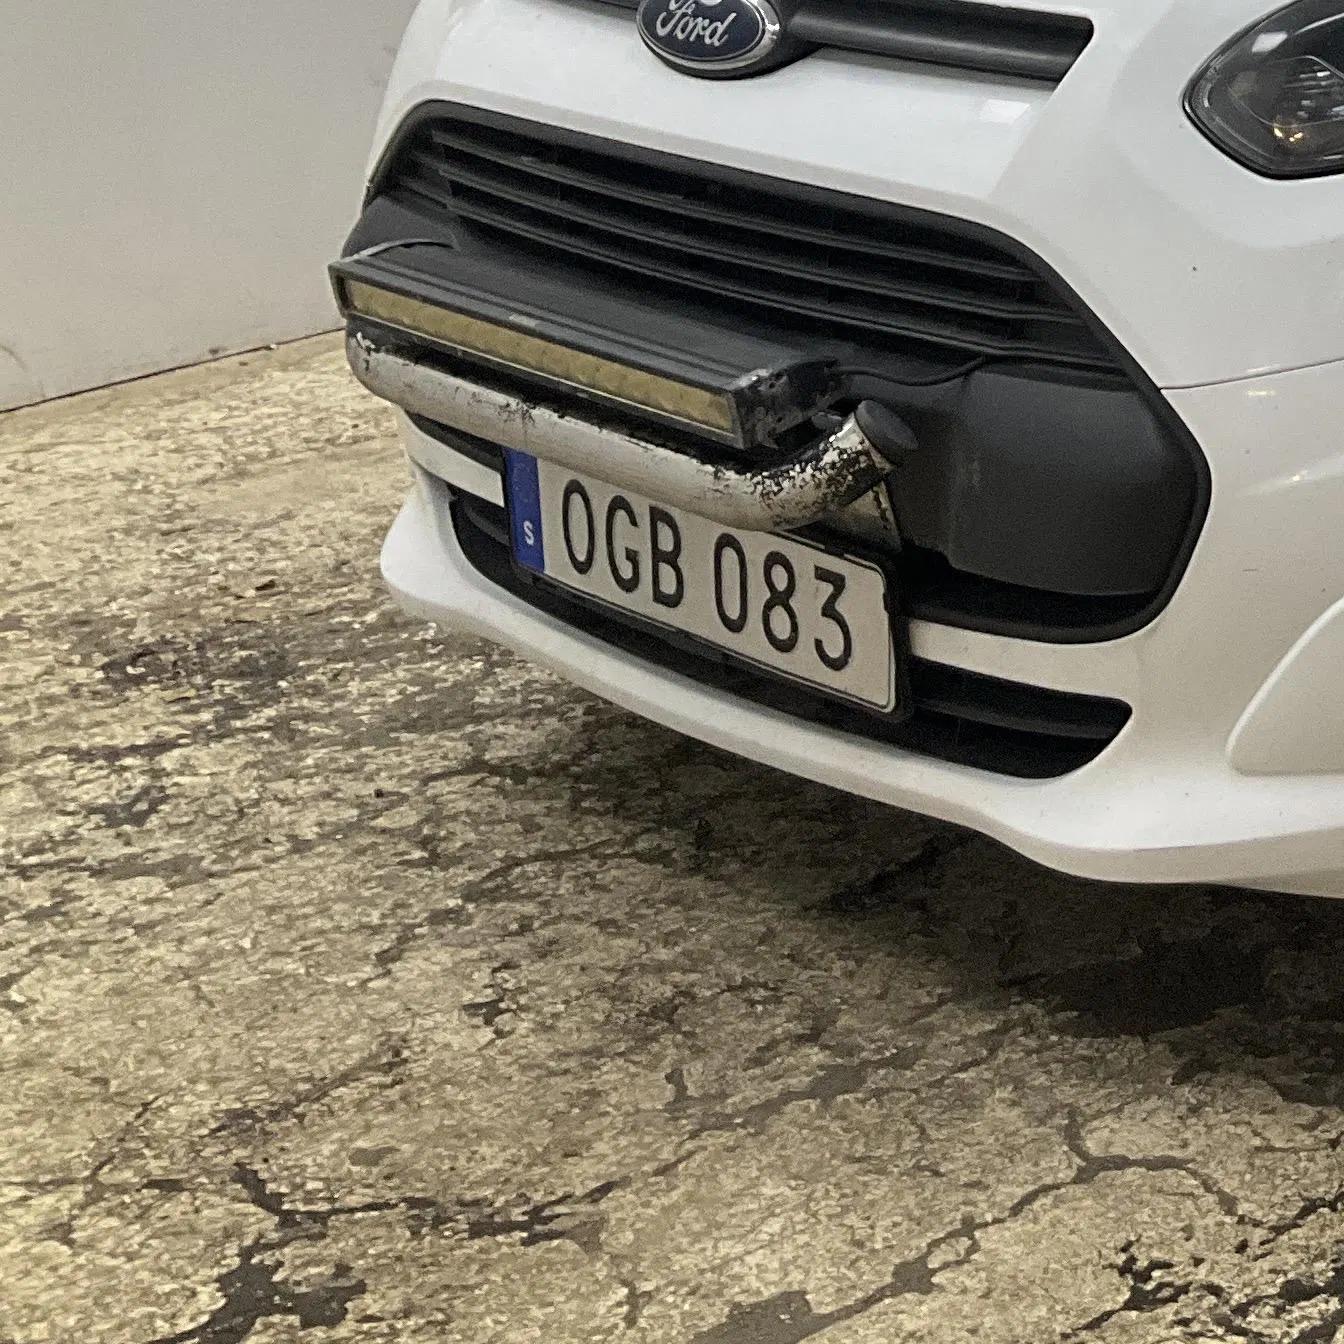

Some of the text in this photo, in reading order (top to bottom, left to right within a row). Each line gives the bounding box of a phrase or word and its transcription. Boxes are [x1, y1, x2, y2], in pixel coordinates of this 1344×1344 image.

[523, 520, 535, 547] S
[561, 478, 853, 671] OGB 083
